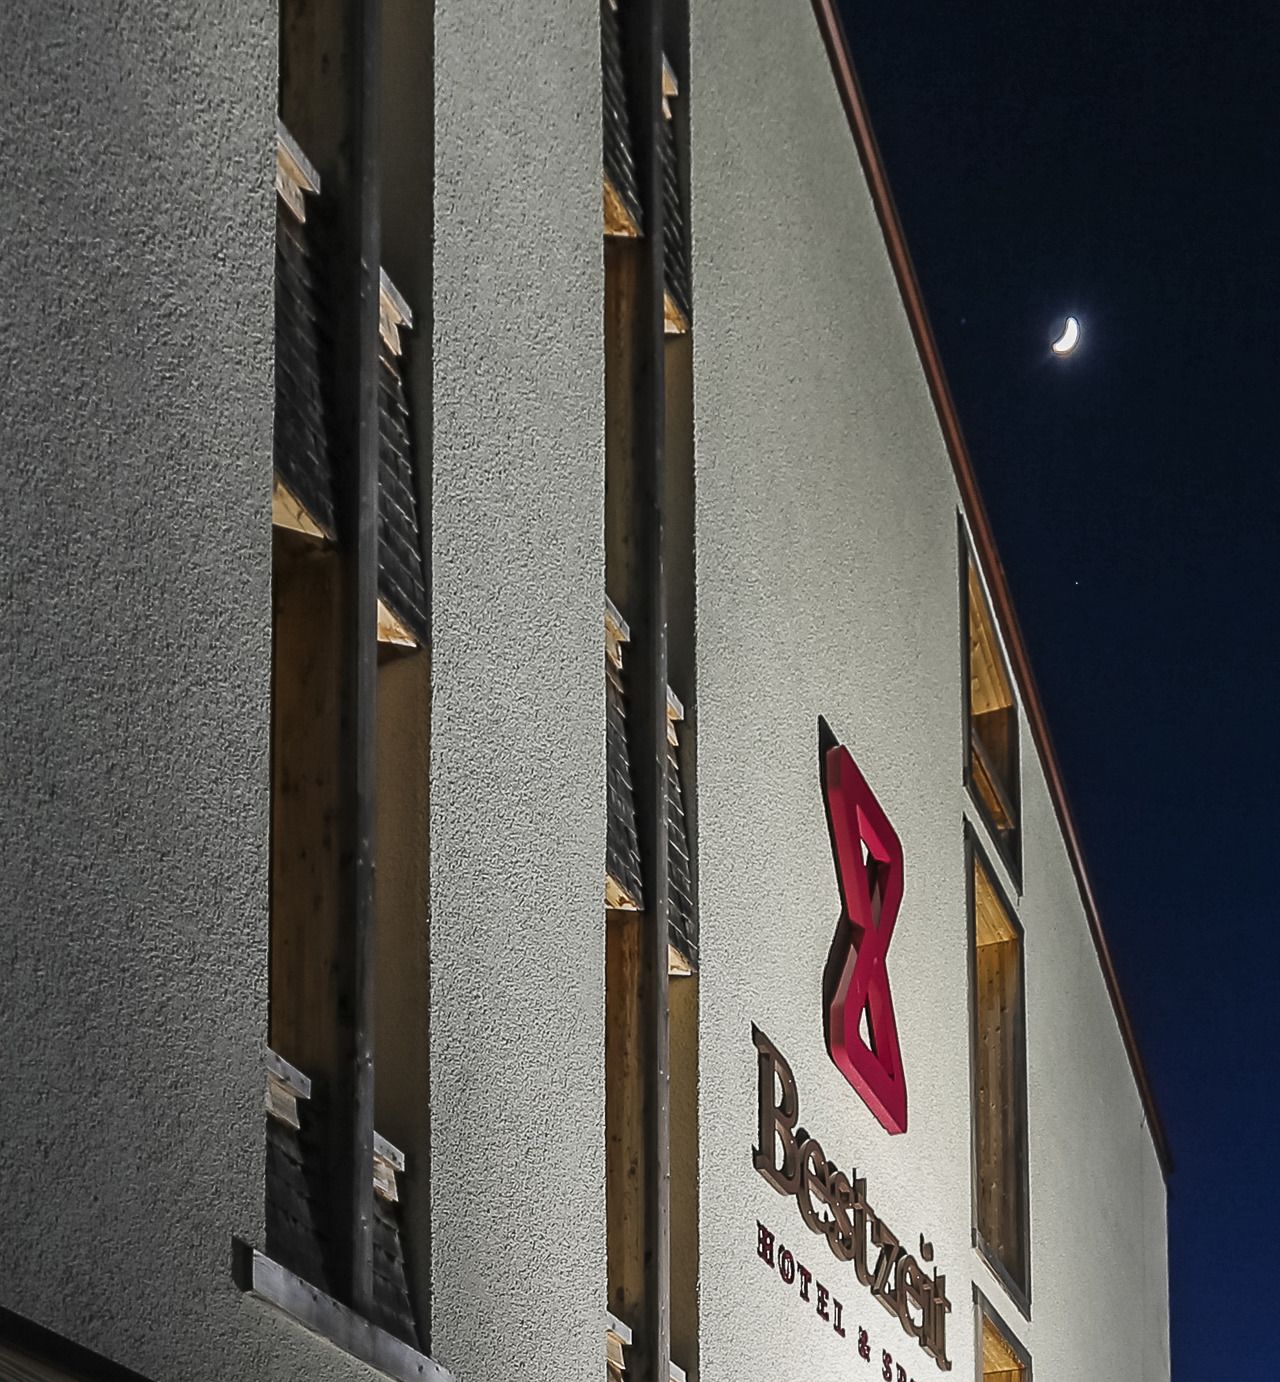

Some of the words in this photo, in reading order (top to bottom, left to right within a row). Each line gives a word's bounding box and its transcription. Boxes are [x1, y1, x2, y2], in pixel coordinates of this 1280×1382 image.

[751, 1020, 952, 1371] Bestzeit
[756, 1219, 846, 1338] HOTEL
[857, 1325, 871, 1363] &
